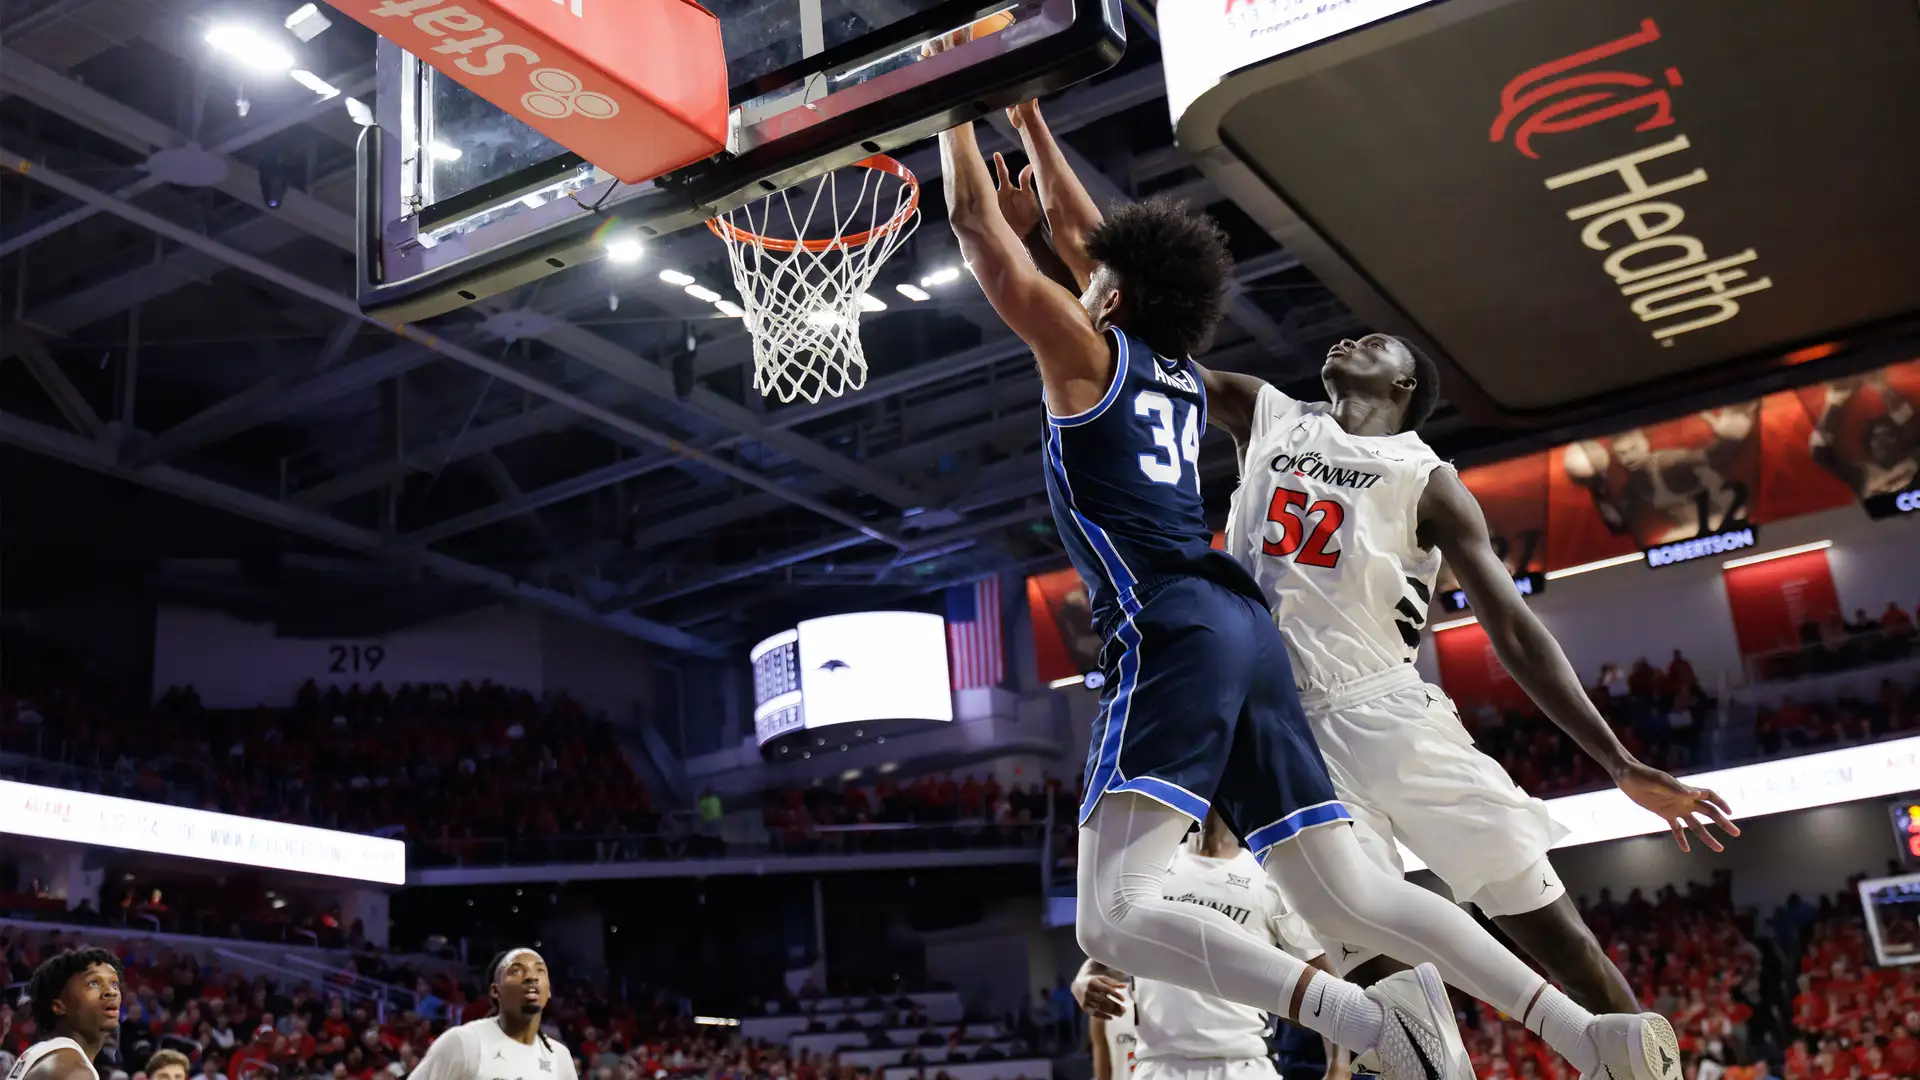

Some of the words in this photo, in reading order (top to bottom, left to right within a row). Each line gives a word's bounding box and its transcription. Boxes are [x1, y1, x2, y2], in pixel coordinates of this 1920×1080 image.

[1544, 133, 1774, 341] Health
[1133, 389, 1201, 497] 34
[1261, 486, 1345, 569] 52
[328, 644, 386, 674] 219
